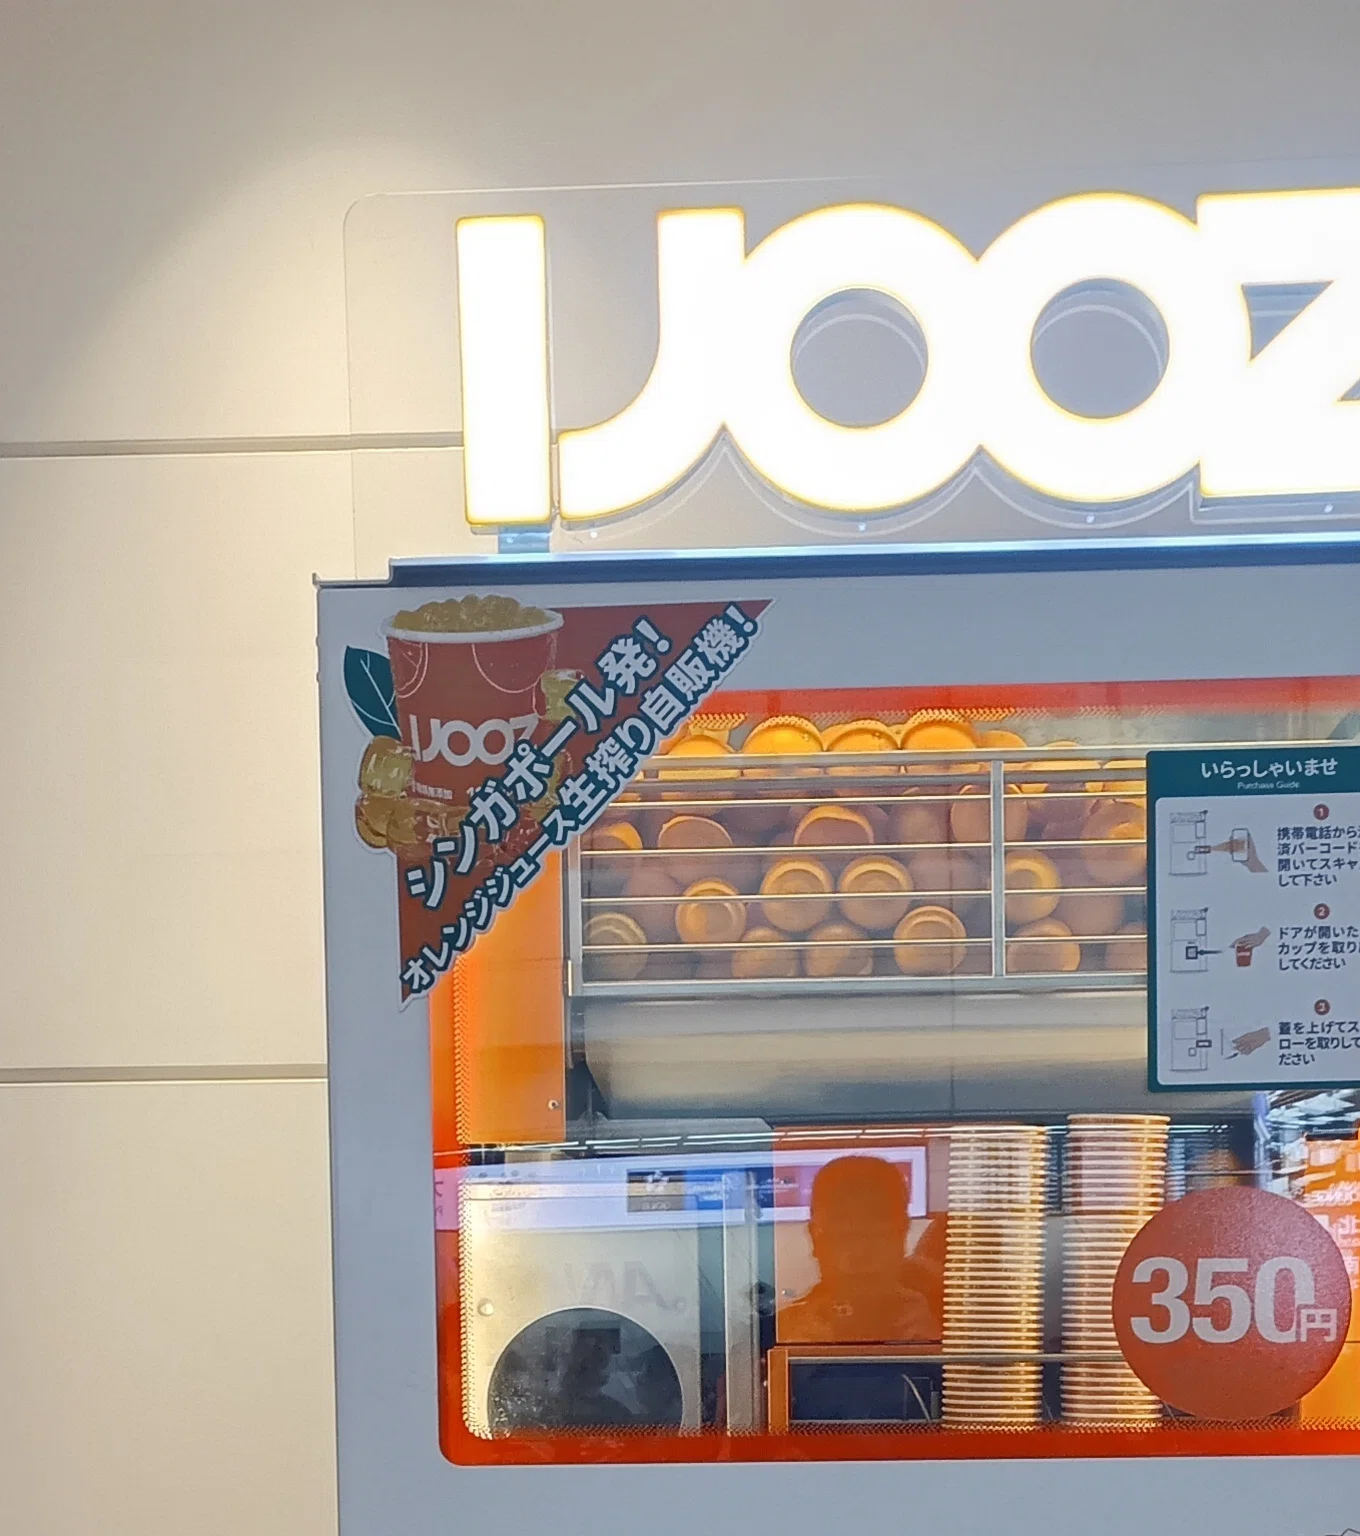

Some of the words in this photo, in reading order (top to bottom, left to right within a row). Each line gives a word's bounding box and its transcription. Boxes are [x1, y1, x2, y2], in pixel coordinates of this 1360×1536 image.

[406, 618, 671, 908] シンガポール発!
[1201, 758, 1338, 778] いらっしゃいませ
[402, 605, 756, 990] オレンジジュース生搾り自販機!
[1278, 874, 1337, 887] して下さい
[1279, 957, 1346, 971] してください
[1279, 1052, 1315, 1066] ださい
[1130, 1256, 1337, 1344] 350円
